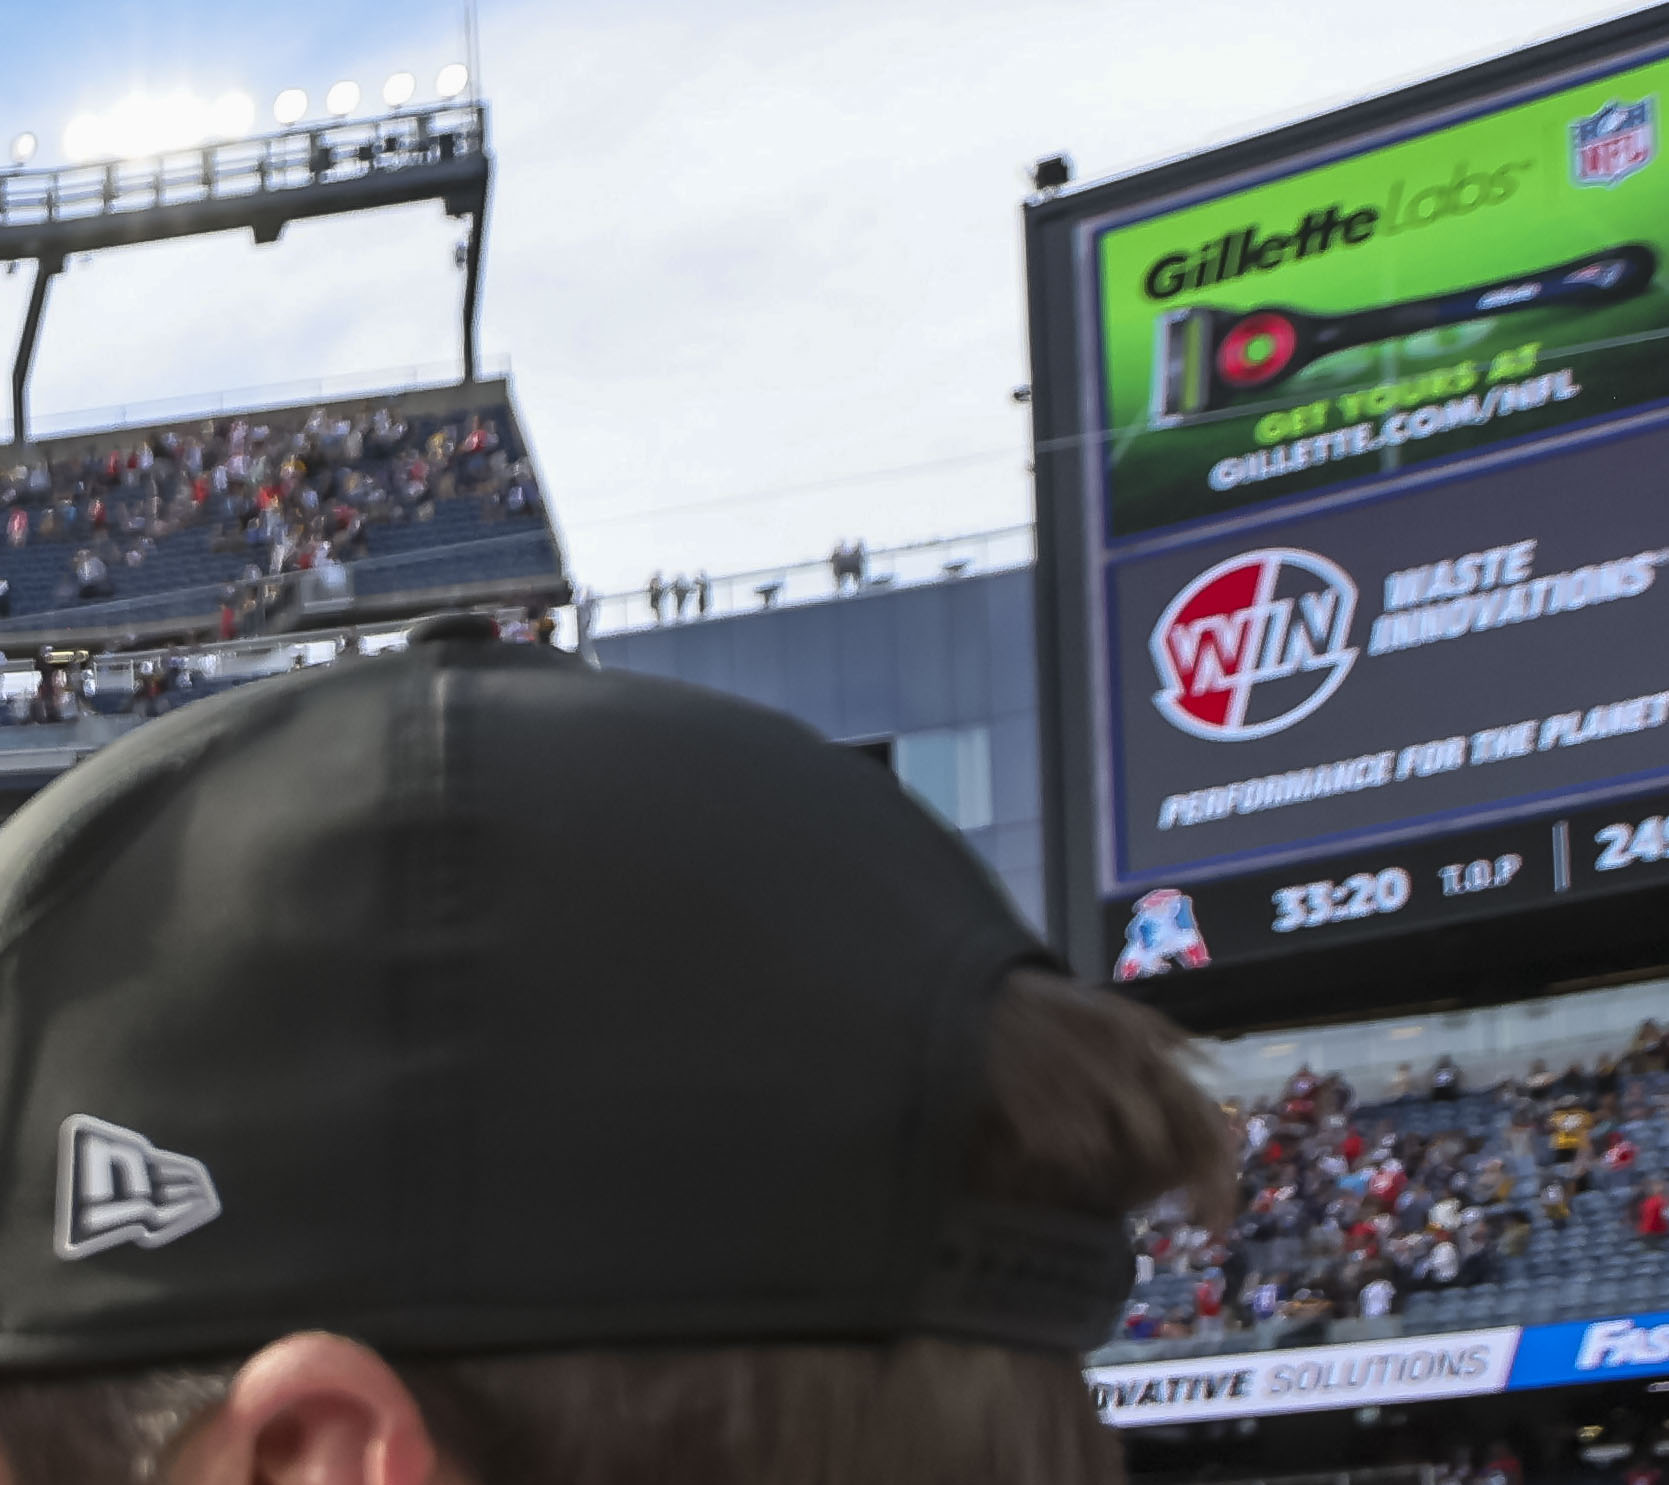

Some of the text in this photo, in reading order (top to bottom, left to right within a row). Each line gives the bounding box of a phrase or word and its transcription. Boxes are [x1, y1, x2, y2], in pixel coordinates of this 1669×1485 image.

[1207, 367, 1582, 492] GILLETTE.COM/NFL
[1254, 340, 1543, 445] GET YOURS AT
[1383, 538, 1538, 612] WASTE
[1158, 750, 1396, 831] PERFORMANCE
[1395, 734, 1467, 781] FOR
[1470, 717, 1540, 767] THE
[1271, 866, 1412, 933] 33:20
[1594, 815, 1669, 872] 24
[1265, 1345, 1490, 1397] SOLUTIONS
